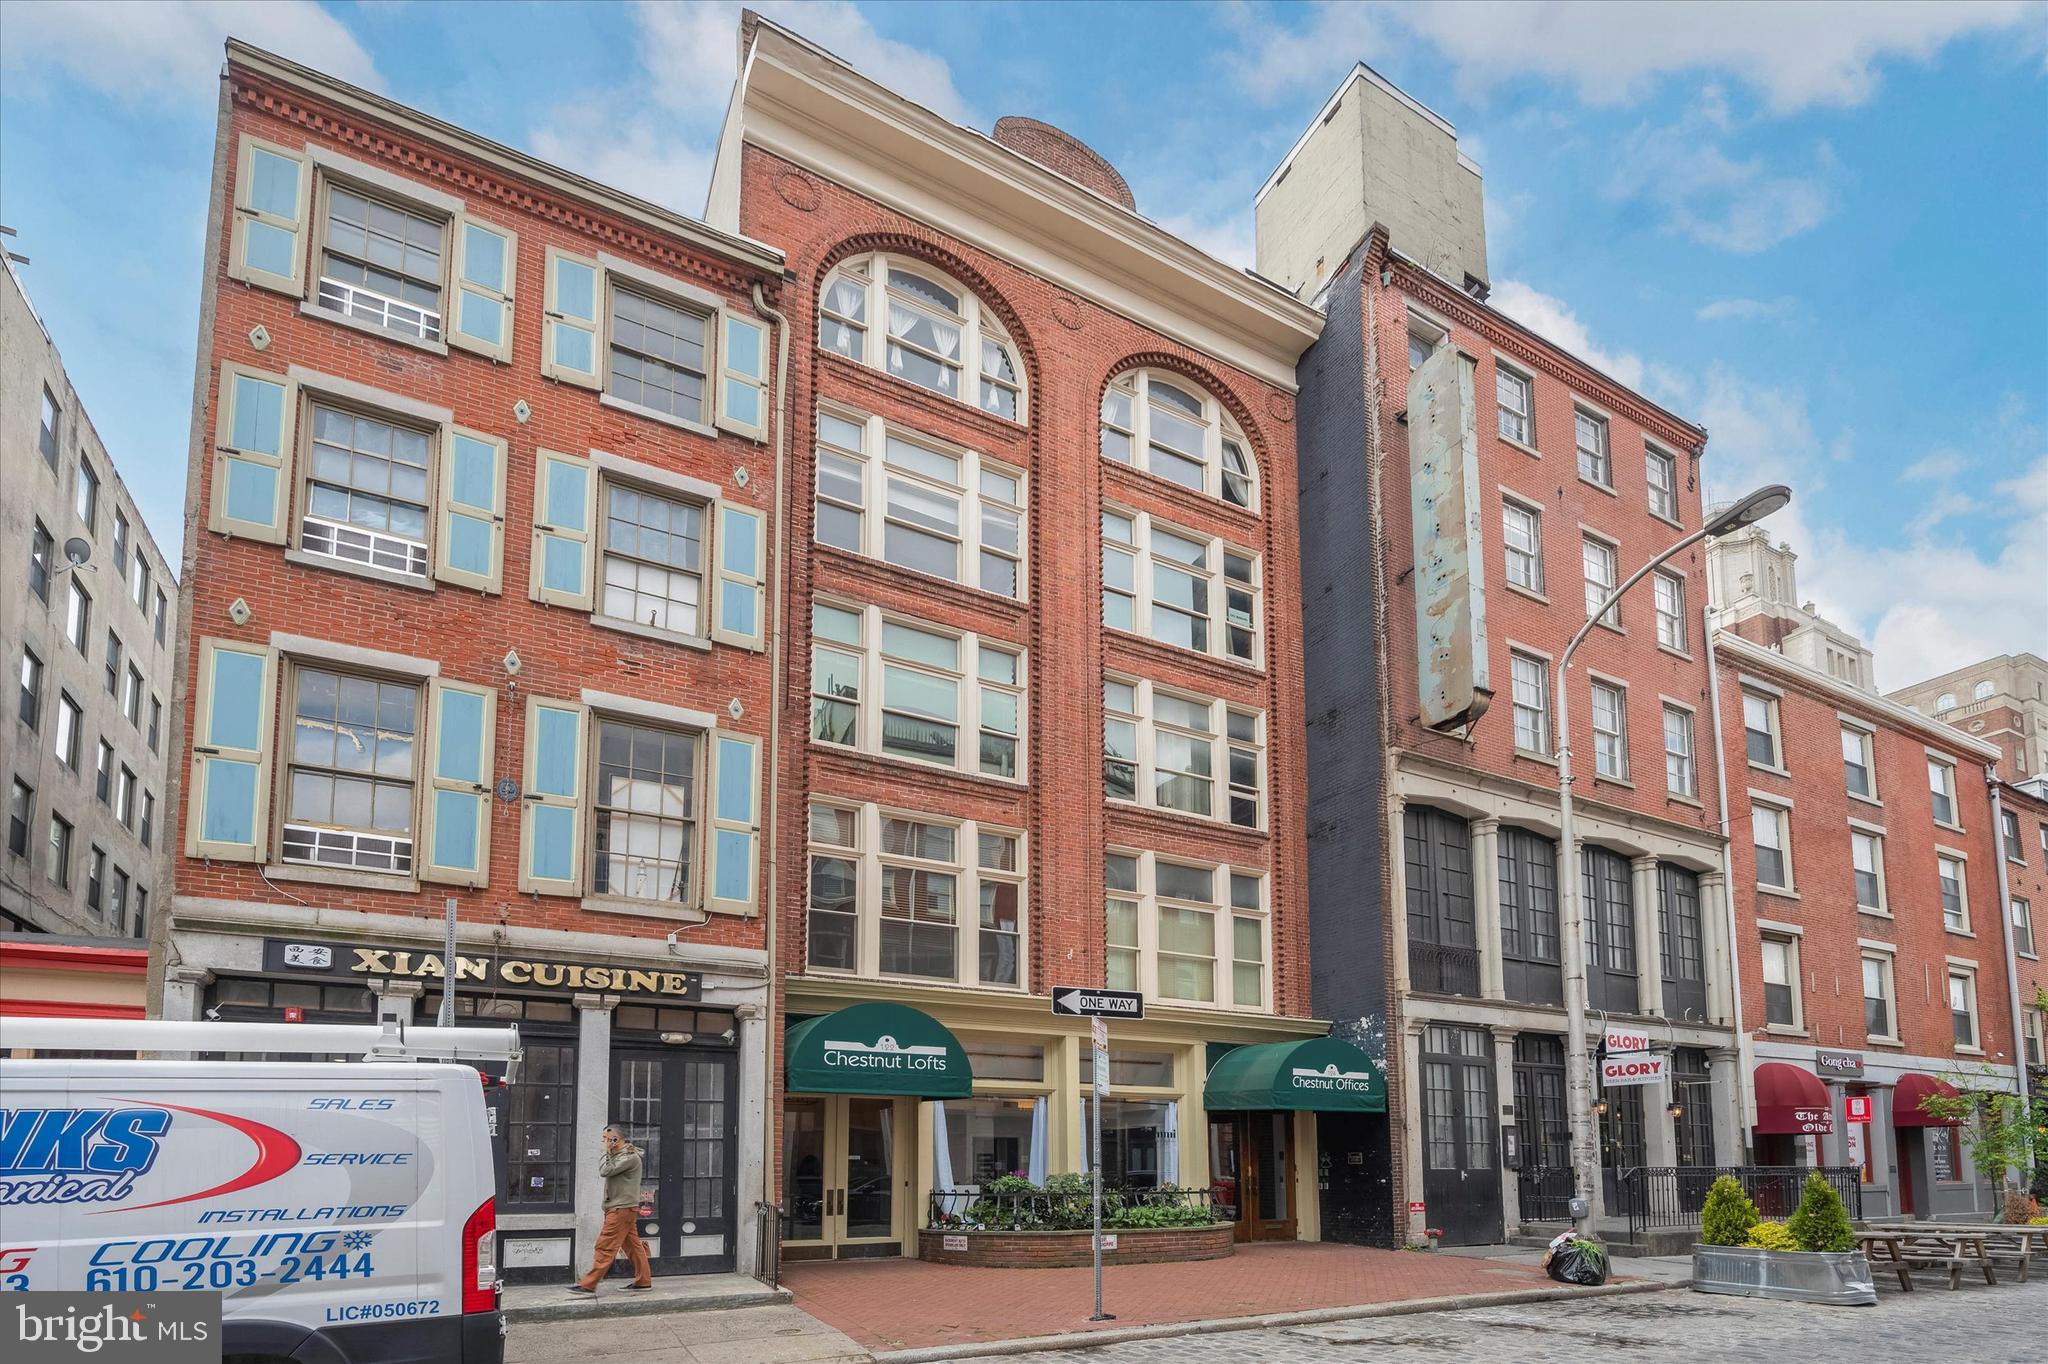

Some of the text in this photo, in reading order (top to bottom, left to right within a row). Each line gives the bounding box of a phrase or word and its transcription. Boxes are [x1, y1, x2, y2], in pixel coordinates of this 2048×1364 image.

[351, 948, 688, 995] XIAN CUISINE
[1080, 996, 1134, 1010] ONE WAY
[880, 1043, 895, 1051] 122
[1607, 1034, 1647, 1052] GLORY
[823, 1050, 947, 1071] Chestnut Lofts
[1821, 1055, 1842, 1070] Gong
[1843, 1056, 1857, 1068] cha
[1605, 1061, 1662, 1077] GLORY
[1292, 1076, 1370, 1092] Chestnut Offices
[307, 1098, 396, 1111] SALES
[1794, 1111, 1819, 1121] The
[303, 1153, 413, 1165] SERVICE
[198, 1205, 408, 1223] INSTALLATIONS
[89, 1231, 342, 1266] COOLING
[86, 1252, 375, 1291] 610-203-2444
[325, 1300, 440, 1323] LIC#050672
